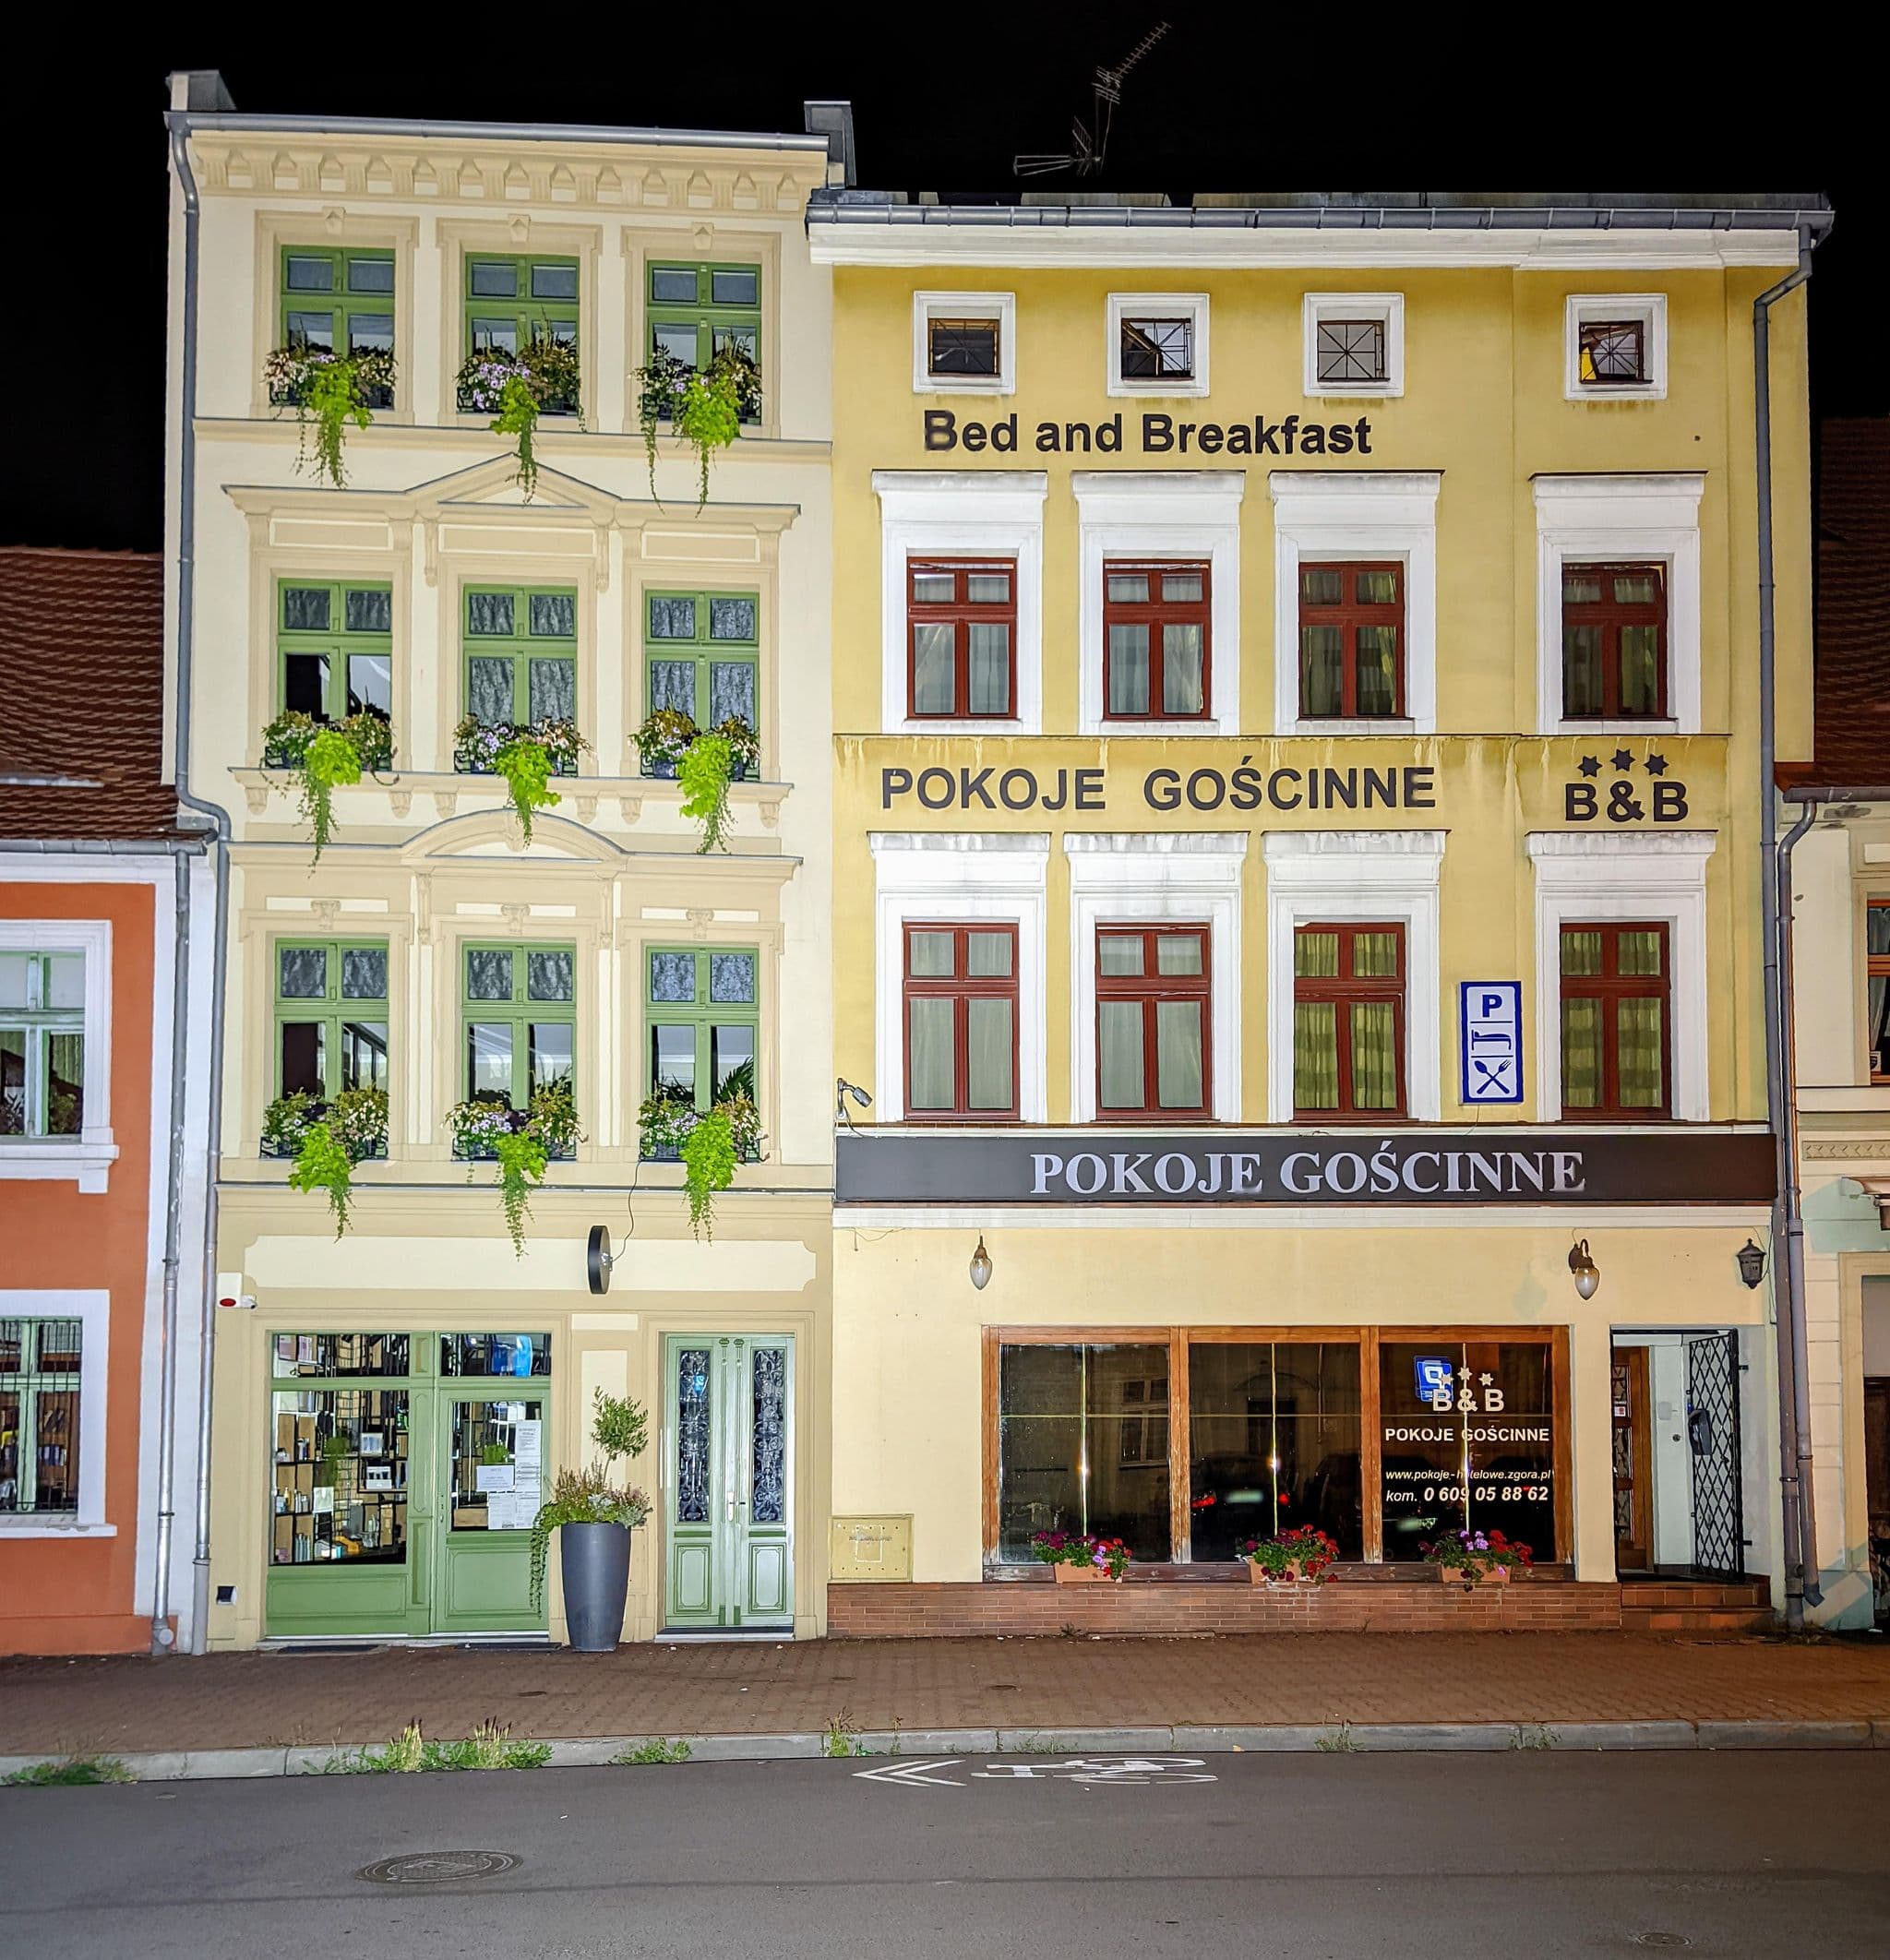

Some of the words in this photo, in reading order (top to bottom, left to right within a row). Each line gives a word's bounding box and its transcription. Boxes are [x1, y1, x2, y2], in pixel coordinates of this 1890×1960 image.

[924, 410, 1018, 452] Bed
[1035, 413, 1122, 452] and
[1142, 413, 1372, 455] Breakfast
[881, 767, 1106, 810] POKOJE
[1143, 755, 1436, 811] GOŚCINNE
[1565, 780, 1689, 823] B&B
[1482, 994, 1502, 1018] P
[1030, 1153, 1263, 1194] POKOJE
[1279, 1140, 1586, 1194] GOŚCINNE
[1432, 1388, 1505, 1412] B&B
[1385, 1428, 1454, 1441] POKOJE
[1461, 1425, 1549, 1441] GOŚCINNE
[1385, 1469, 1551, 1482] www.pokoje-htelowe.zgora.pl
[1385, 1489, 1418, 1502] kom.
[1424, 1487, 1435, 1502] 0
[1439, 1487, 1470, 1503] 609
[1475, 1487, 1497, 1501] 05
[1501, 1487, 1523, 1501] 88
[1527, 1486, 1549, 1501] 62
